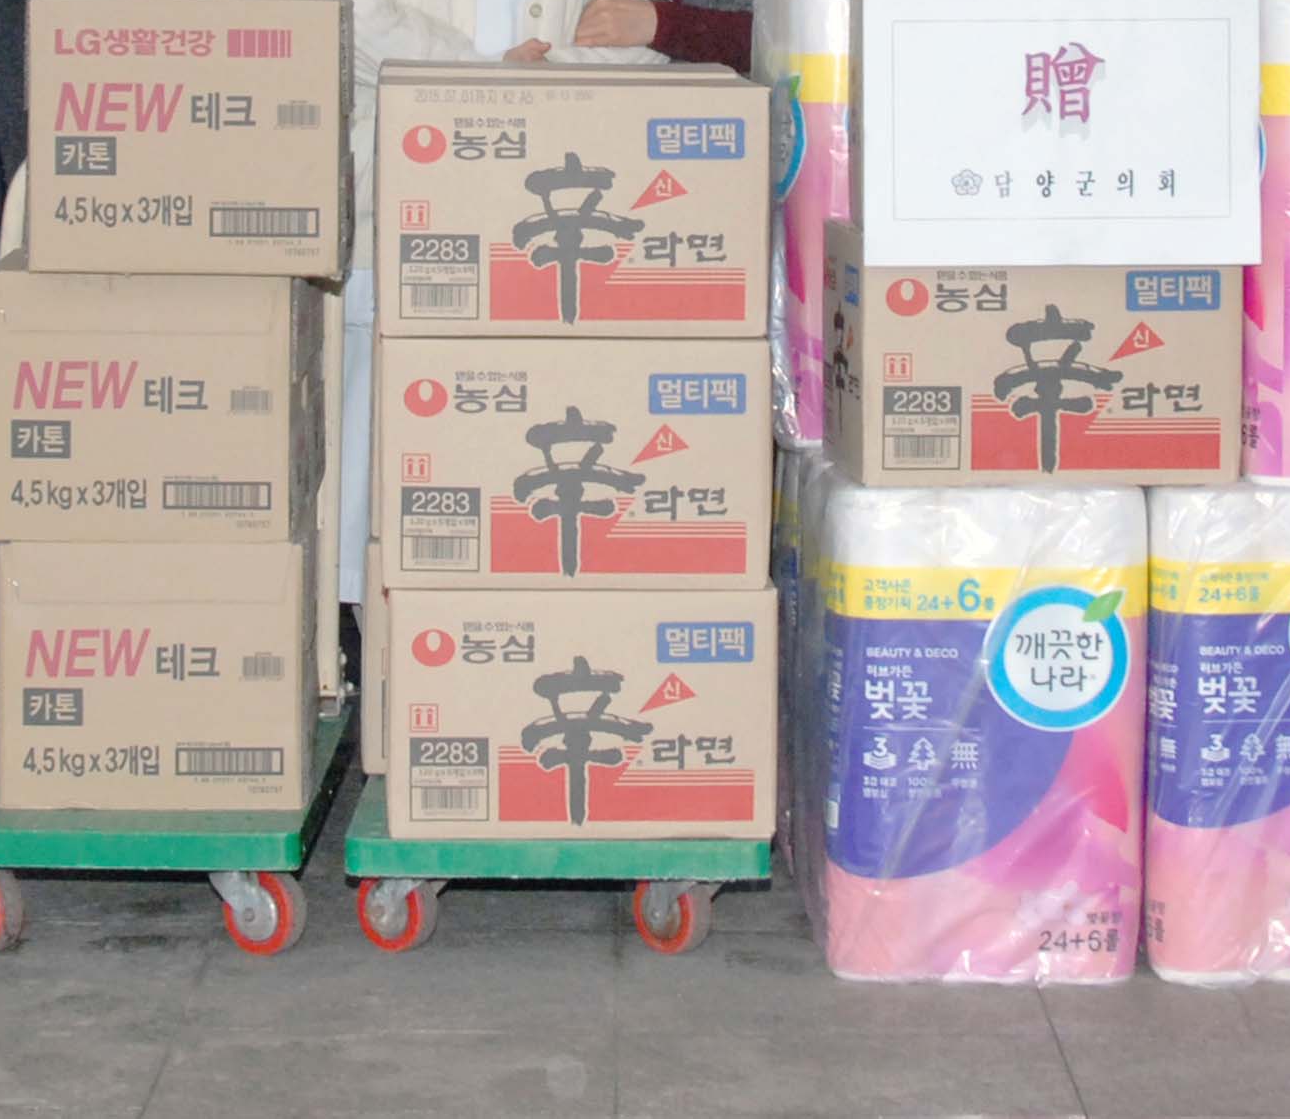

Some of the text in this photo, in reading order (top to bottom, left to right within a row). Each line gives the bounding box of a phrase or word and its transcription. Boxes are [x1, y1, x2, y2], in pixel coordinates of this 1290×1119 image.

[55, 28, 215, 58] LG생활건강
[1022, 42, 1105, 123] 贈
[53, 82, 256, 132] NEW 테크
[452, 130, 527, 161] 농심
[656, 124, 736, 153] 멀티팩
[62, 142, 110, 171] 카톤
[655, 179, 673, 197] 신
[411, 239, 469, 260] 2283
[512, 151, 645, 325] 辛
[643, 231, 727, 267] 라면
[935, 283, 1008, 313] 농심
[1134, 275, 1212, 305] 멀티팩
[1133, 330, 1150, 348] 신
[13, 361, 208, 414] NEW 테크
[453, 384, 527, 413] 농심
[657, 380, 738, 408] 멀티팩
[893, 391, 951, 412] 2283
[993, 304, 1123, 474] 辛
[1122, 383, 1203, 417] 라면
[17, 426, 65, 453] 카톤
[656, 432, 673, 451] 신
[412, 491, 470, 514] 2283
[513, 405, 646, 578] 辛
[644, 485, 728, 521] 라면
[25, 628, 220, 680] NEW 테크
[461, 634, 535, 664] 농심
[666, 628, 746, 657] 멀티팩
[866, 647, 911, 659] BEAUTY
[1016, 630, 1104, 662] 깨끗한
[664, 682, 681, 700] 신
[1031, 666, 1088, 693] 나라
[29, 694, 77, 721] 카톤
[864, 680, 933, 720] 벚꽃
[1197, 676, 1261, 714] 벚꽃
[420, 742, 478, 764] 2283
[521, 655, 654, 827] 辛
[652, 734, 736, 770] 라면
